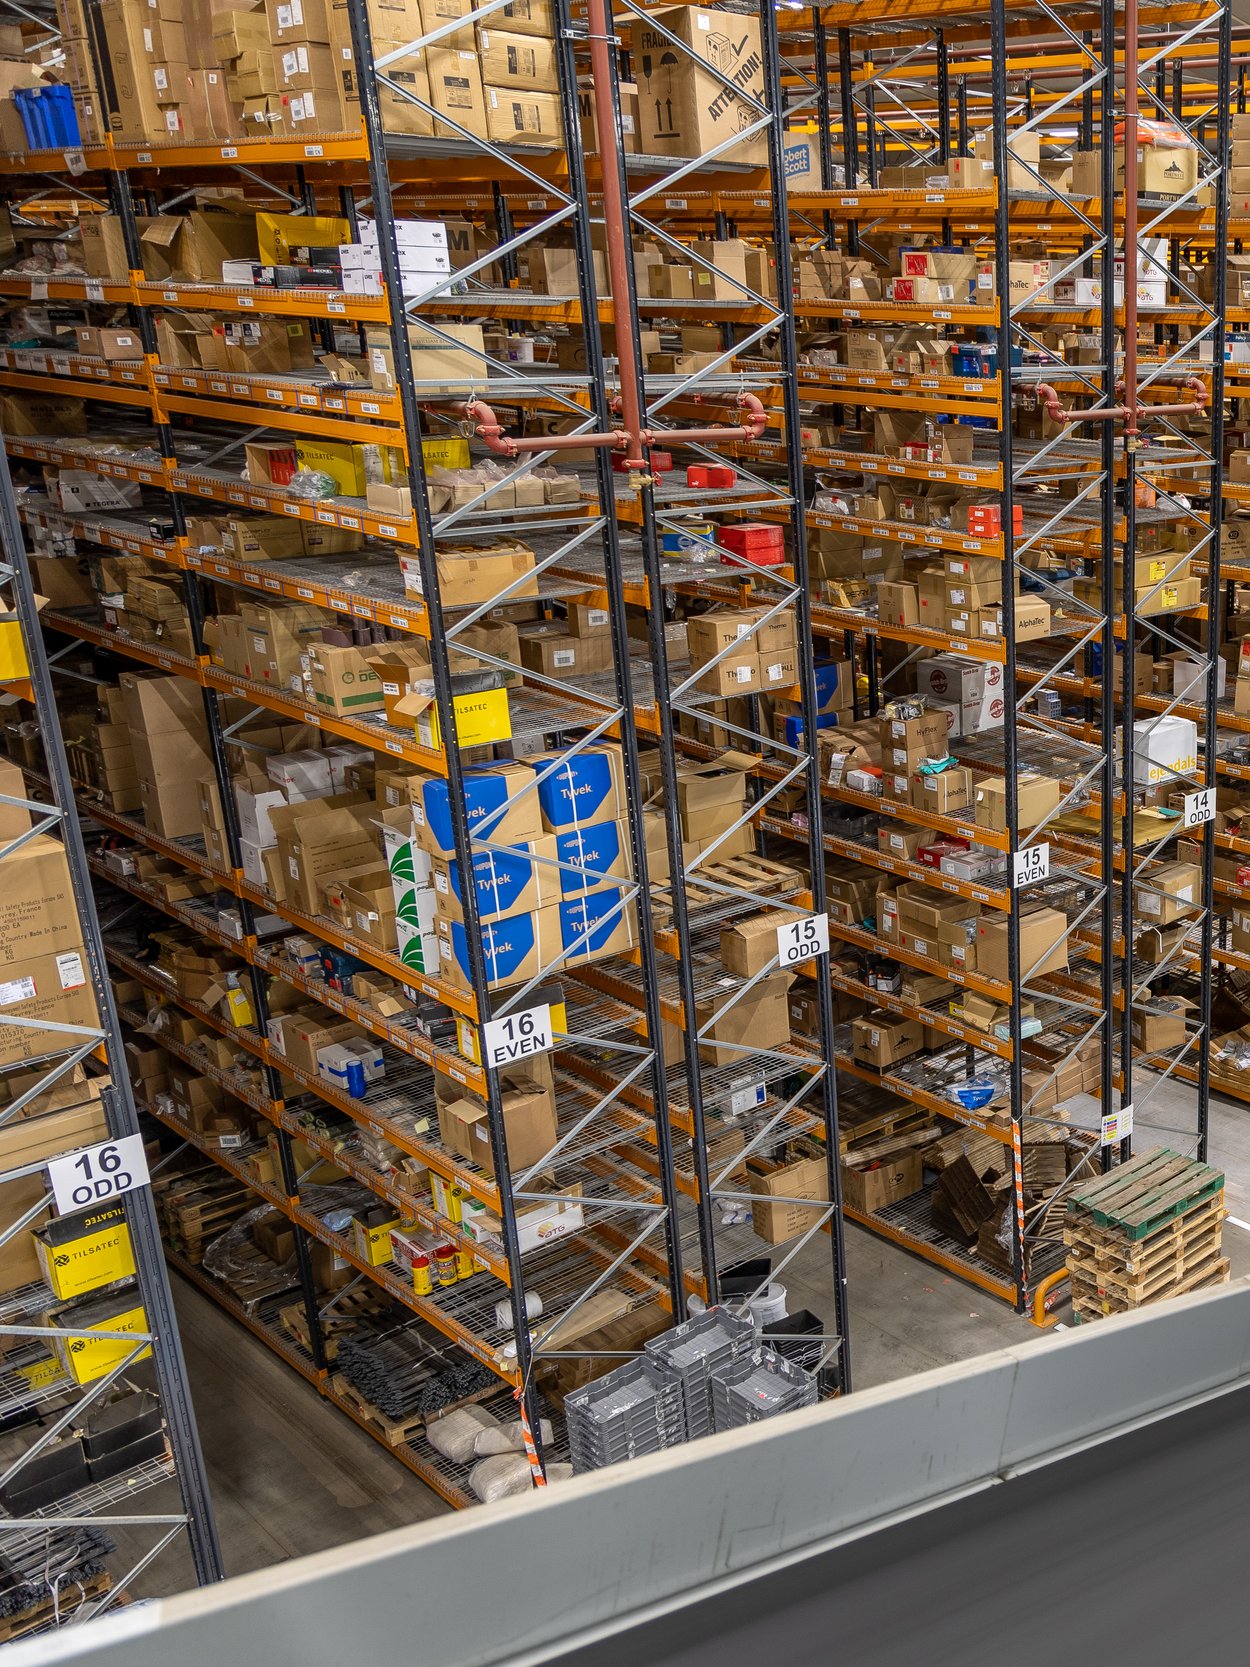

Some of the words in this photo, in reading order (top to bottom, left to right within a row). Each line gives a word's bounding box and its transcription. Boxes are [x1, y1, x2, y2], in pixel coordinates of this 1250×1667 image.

[641, 30, 678, 49] FRAGIL
[707, 51, 763, 122] ATTETION!
[784, 148, 807, 164] obert
[784, 159, 808, 175] Scott
[1009, 280, 1030, 289] haTec
[305, 451, 335, 461] TILSATEC
[423, 451, 450, 459] LSATEC
[768, 623, 787, 631] Thermo
[1018, 617, 1045, 629] AlphaTec
[916, 726, 938, 736] HyFlex
[560, 783, 593, 800] Tyvek
[1192, 792, 1209, 810] 14
[466, 806, 486, 819] vek
[1189, 808, 1211, 824] ODD
[568, 850, 600, 866] Tyvek
[1023, 847, 1040, 868] 15
[477, 874, 511, 890] Tyvek
[1017, 864, 1045, 884] EVEN
[19, 905, 42, 914] France
[790, 919, 816, 944] 15
[484, 942, 512, 959] yvek
[788, 940, 821, 961] ODD
[34, 1003, 55, 1013] France
[502, 1012, 534, 1041] 16
[494, 1032, 546, 1064] EVEN
[74, 1145, 121, 1181] 16
[72, 1171, 133, 1205] ODD
[72, 1237, 121, 1260] TILSATEC
[87, 1322, 135, 1346] TILTEC
